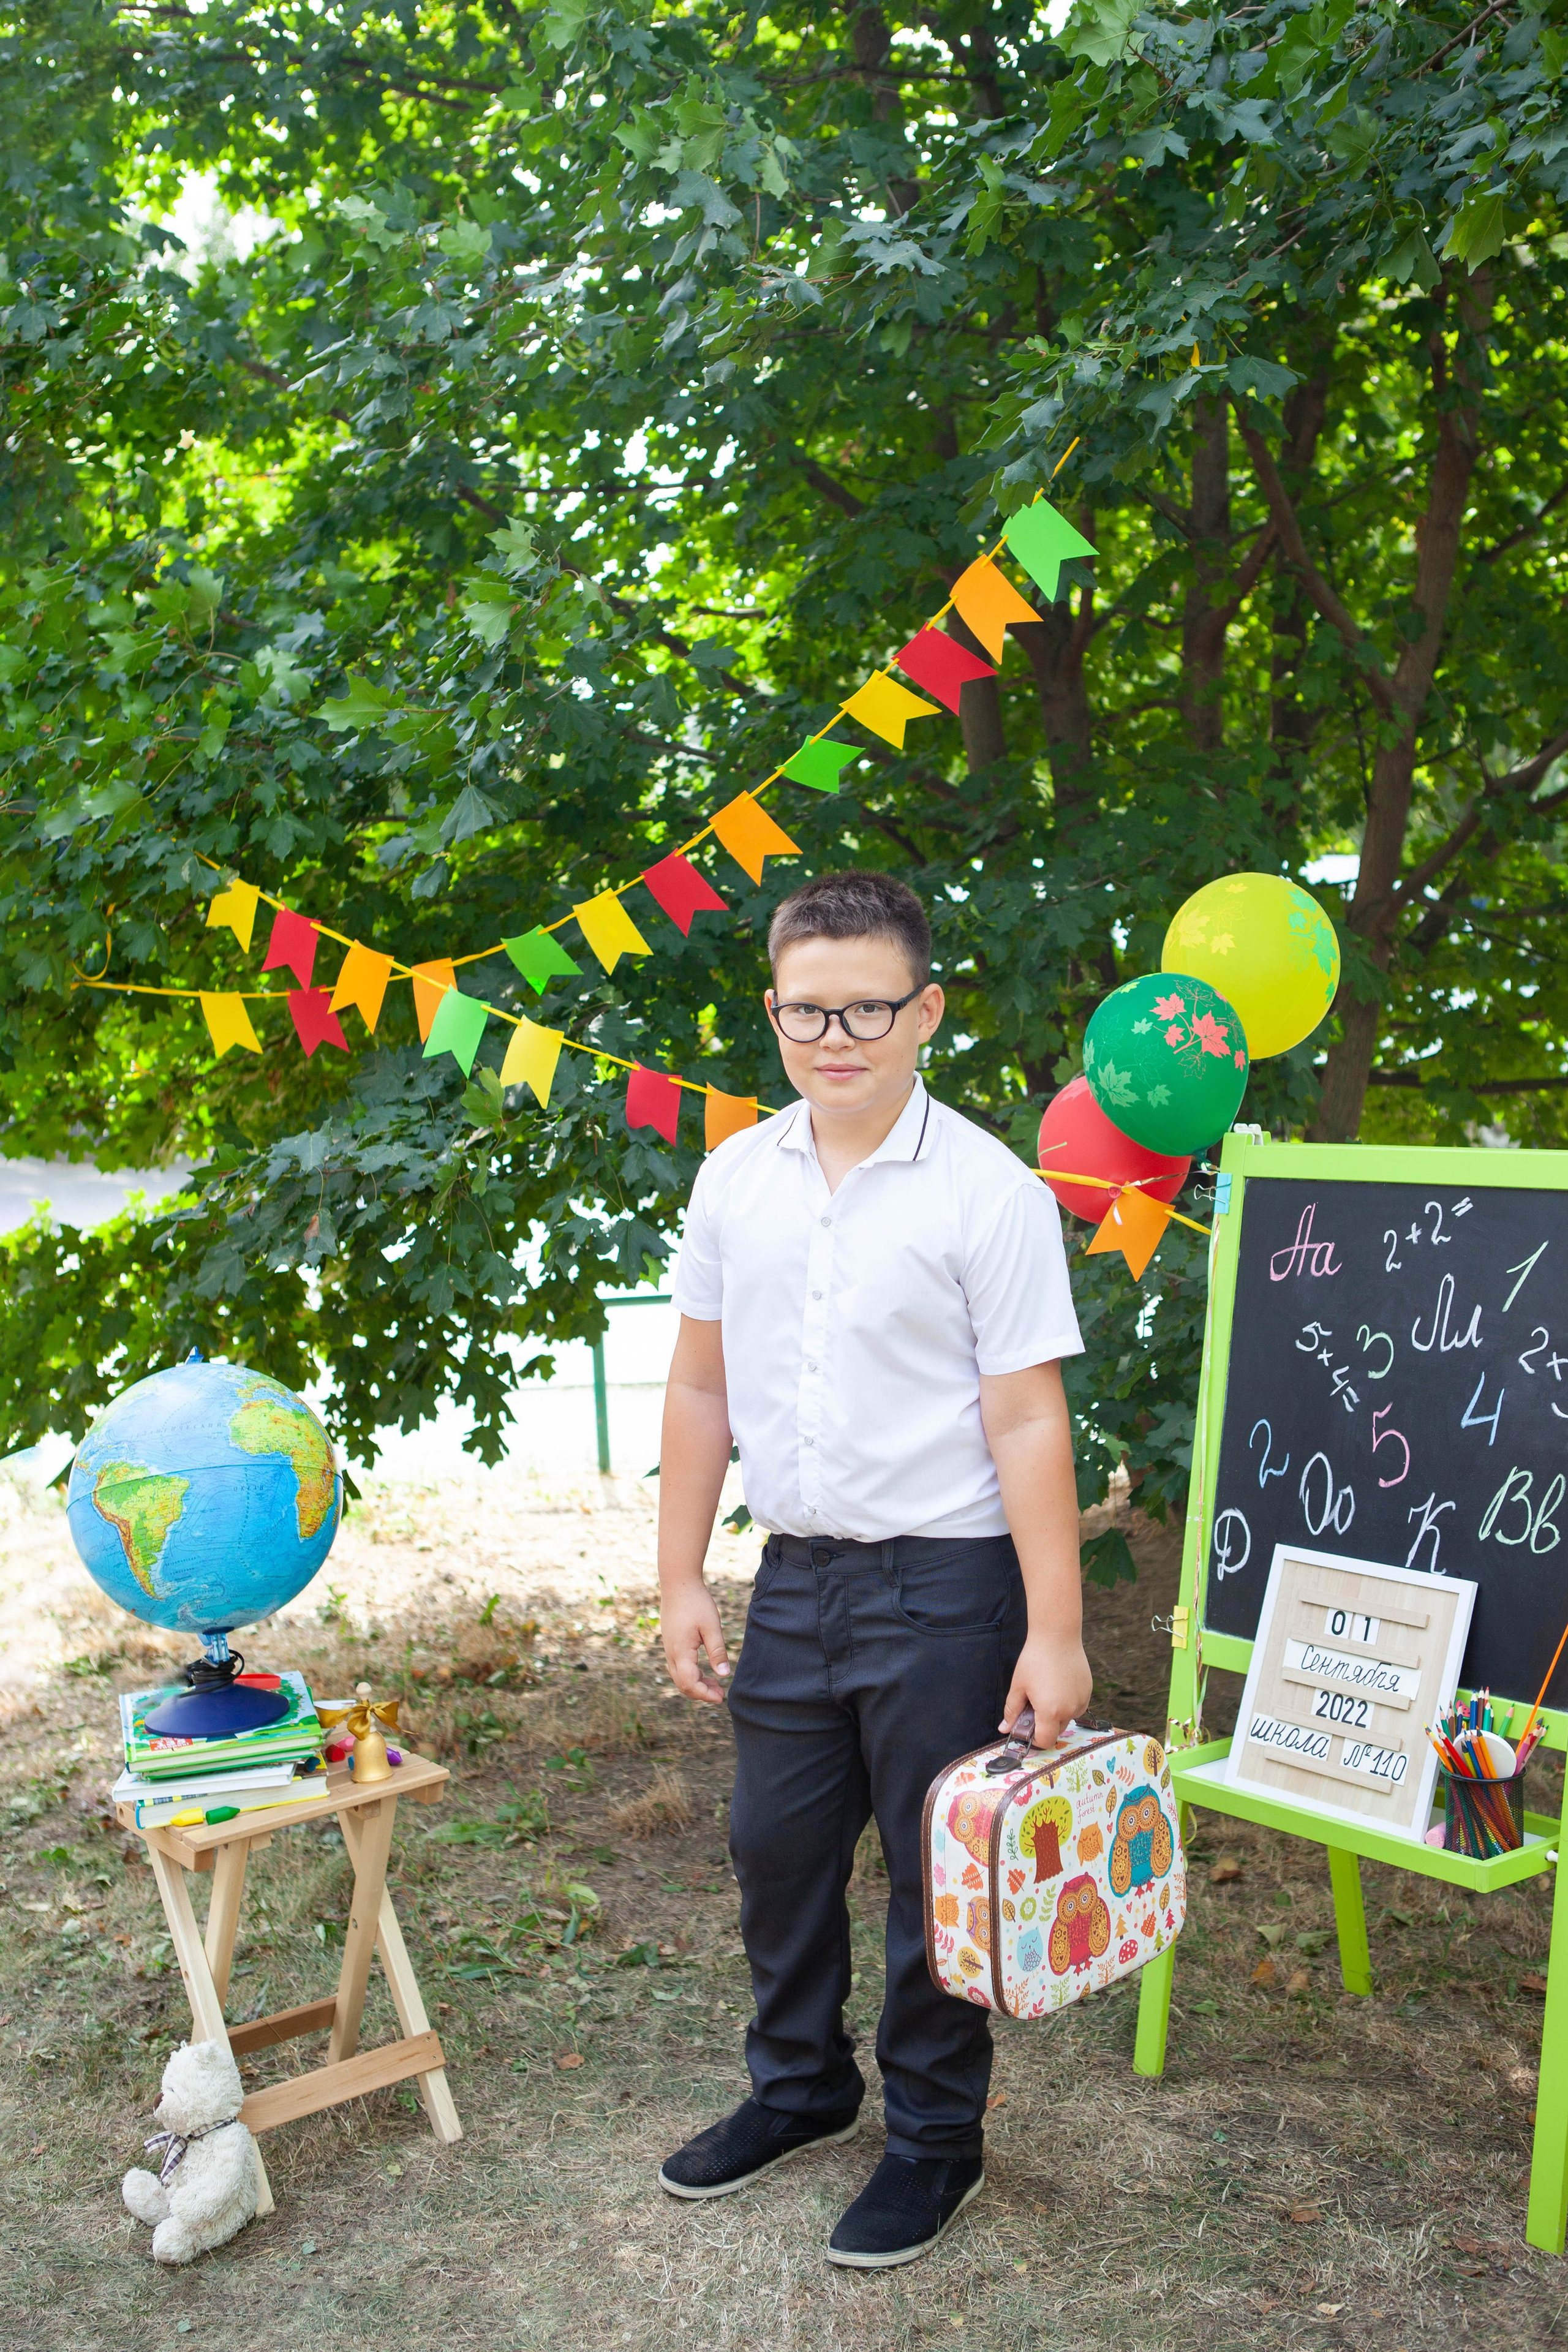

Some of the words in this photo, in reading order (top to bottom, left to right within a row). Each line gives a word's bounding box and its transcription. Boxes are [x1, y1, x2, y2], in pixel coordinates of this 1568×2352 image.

[1502, 1240, 1549, 1313] 1
[1356, 1324, 1394, 1379] 3
[1461, 1371, 1504, 1446] 4
[1250, 1419, 1290, 1488] 2
[1372, 1401, 1410, 1488] 5
[1300, 1645, 1401, 1692] Сентября
[1315, 1691, 1368, 1728] 2022
[1076, 1792, 1104, 1809] autumn
[1077, 1803, 1095, 1825] forest
